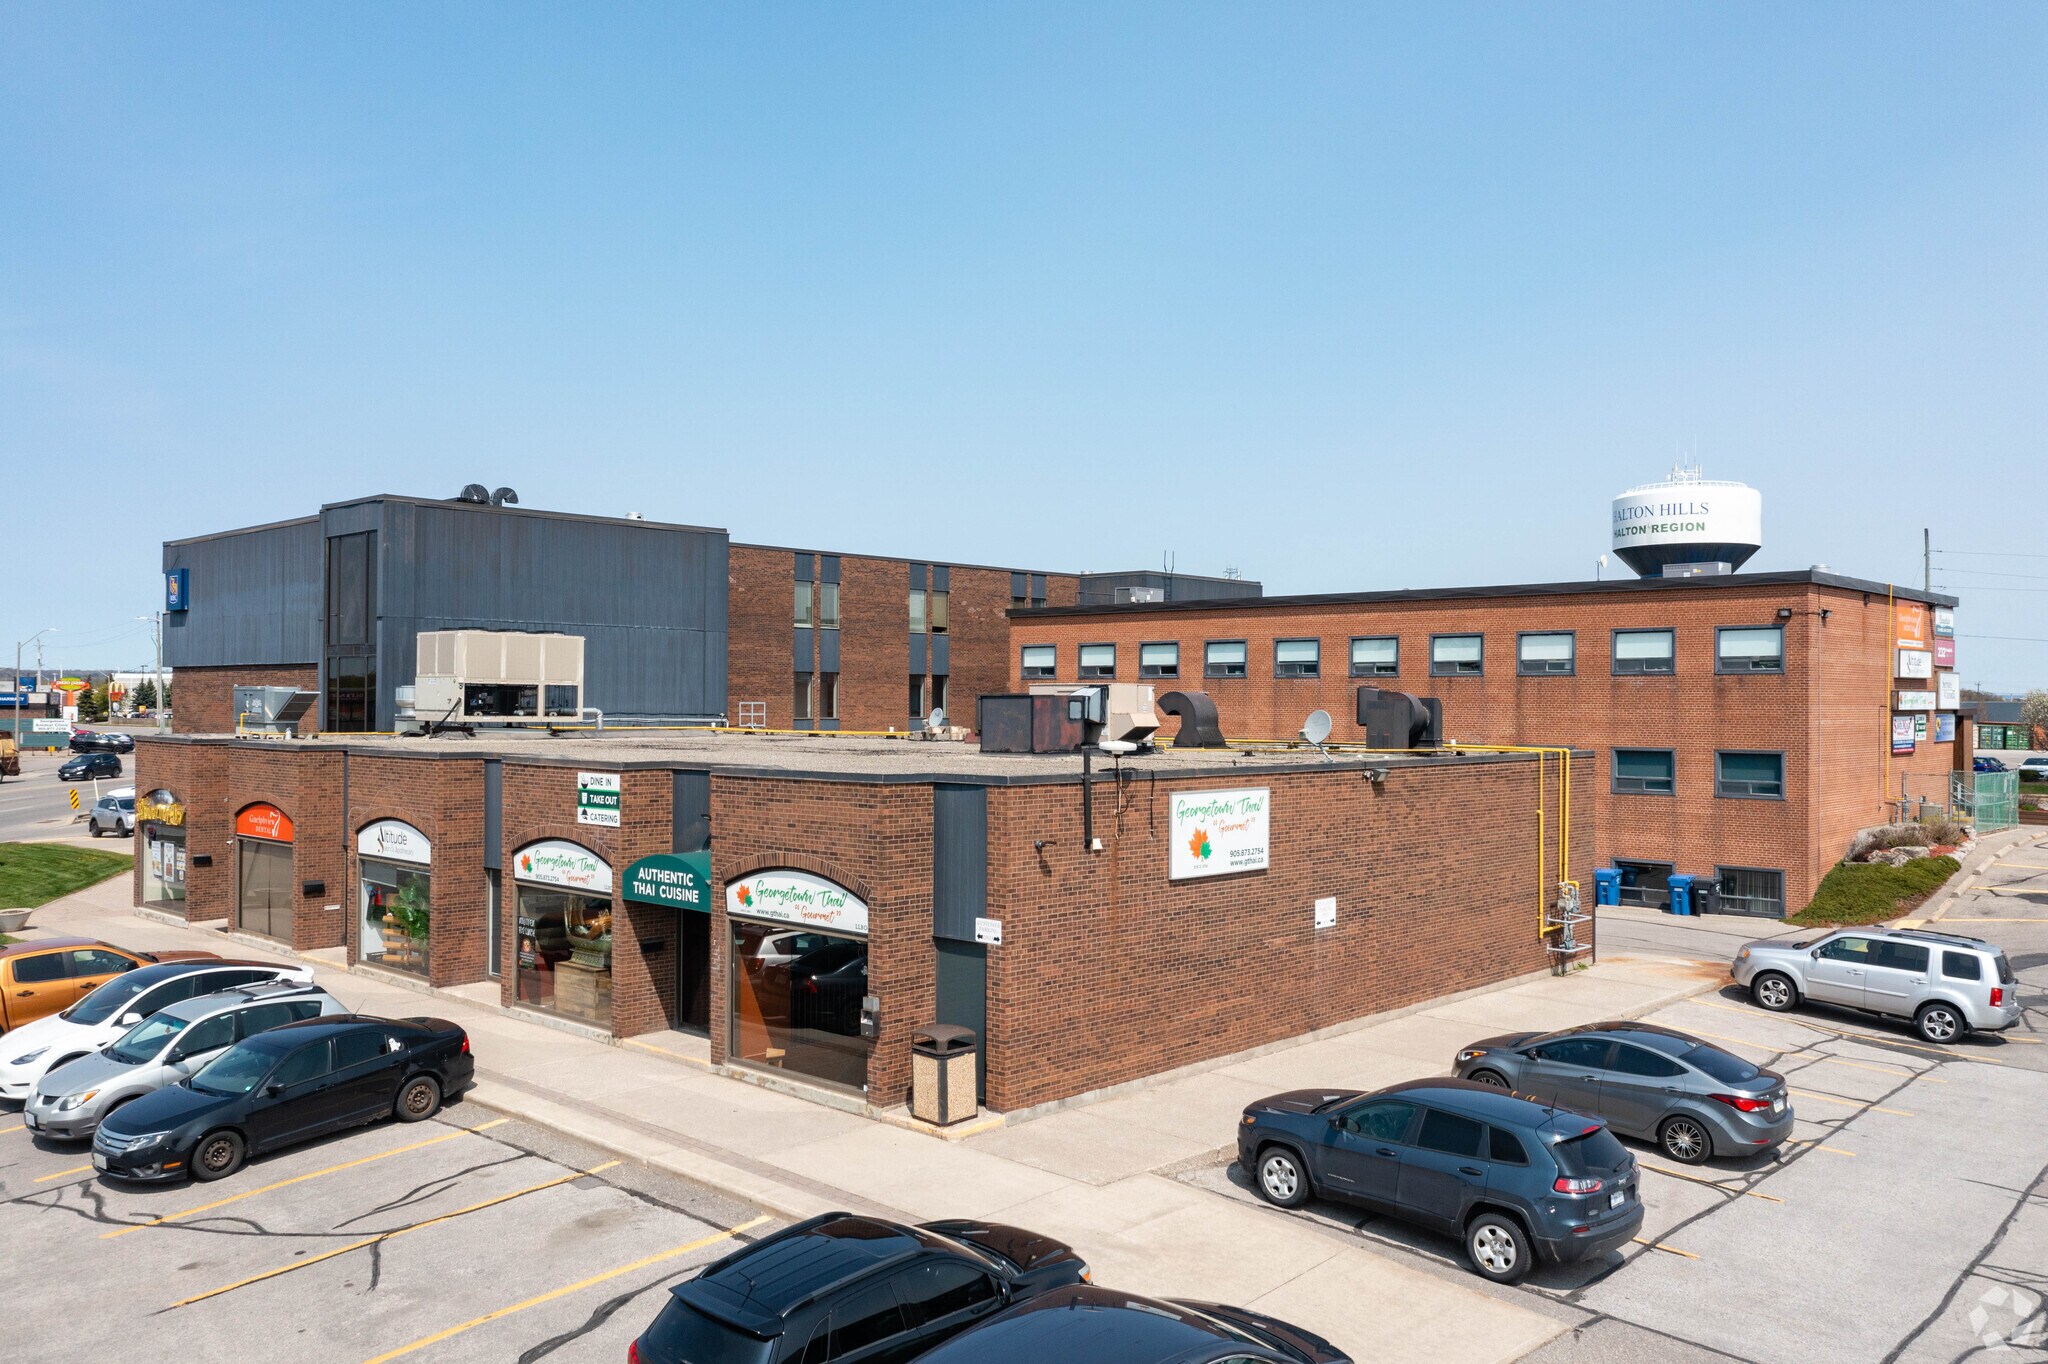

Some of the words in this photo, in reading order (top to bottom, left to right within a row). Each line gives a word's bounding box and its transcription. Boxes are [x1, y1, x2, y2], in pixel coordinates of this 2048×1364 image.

[1660, 502, 1709, 516] HILLS
[1614, 525, 1647, 538] HALTON
[1651, 522, 1705, 533] REGION
[590, 777, 604, 786] DINE
[606, 778, 612, 787] IN
[590, 795, 605, 804] TAKE
[605, 796, 618, 805] OUT
[1177, 799, 1235, 826] Georgetown
[1237, 796, 1264, 815] Thai
[590, 813, 618, 823] CATERING
[255, 825, 272, 834] DENTAL
[1230, 848, 1264, 858] 905.873.2754
[534, 850, 576, 871] Georgetown
[577, 857, 600, 872] Thai
[1230, 857, 1264, 867] www.gthai.ca
[638, 867, 694, 887] AUTHENTIC
[633, 881, 656, 897] THAI
[659, 885, 699, 904] CUISINE
[755, 880, 816, 906] Georgetown
[817, 890, 849, 908] Thai
[756, 908, 790, 919] www.gthai.ca
